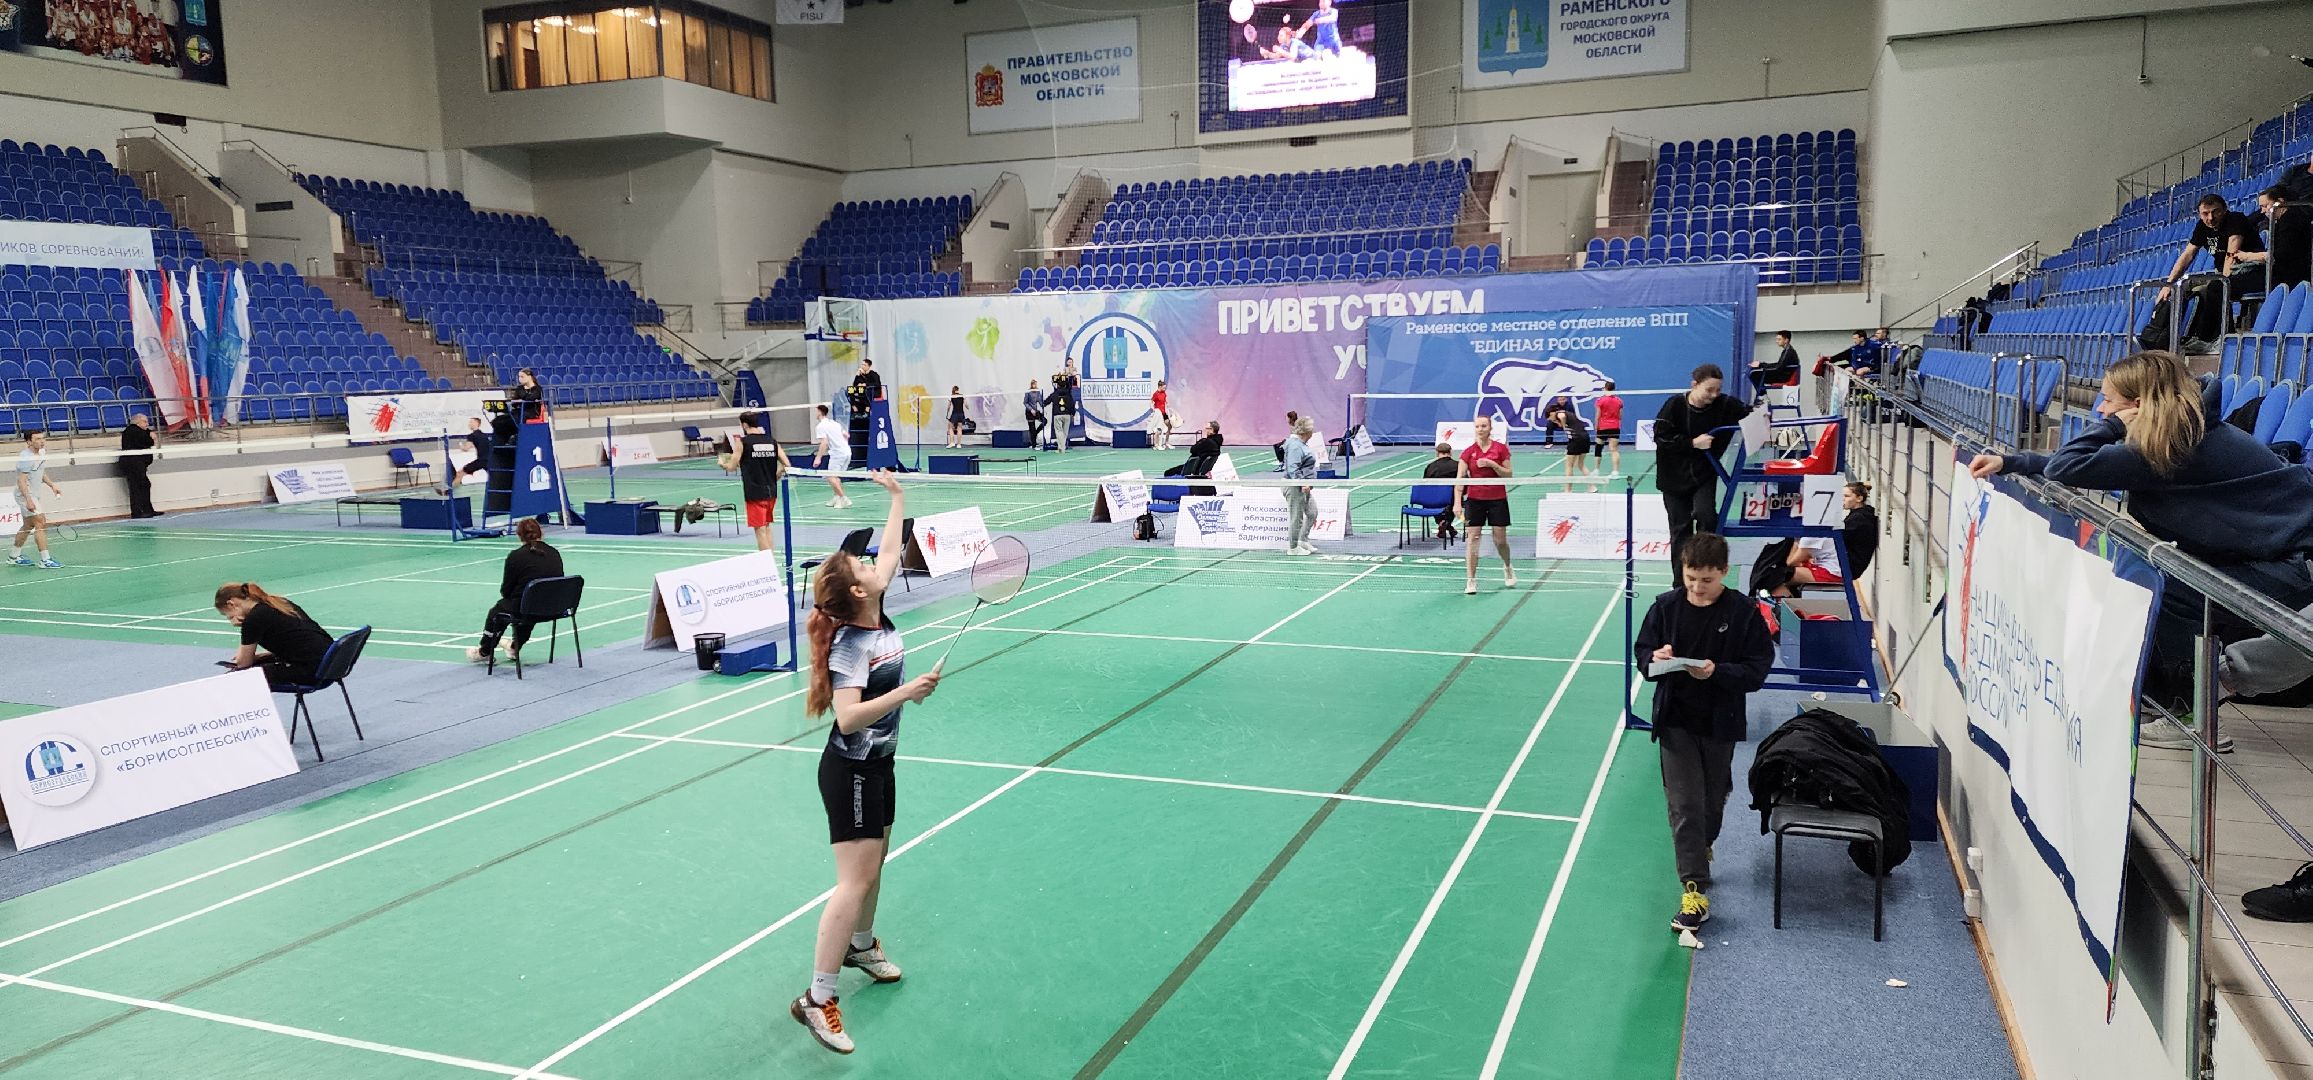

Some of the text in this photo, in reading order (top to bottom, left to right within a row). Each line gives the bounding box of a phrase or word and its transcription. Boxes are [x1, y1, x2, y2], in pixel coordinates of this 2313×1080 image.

[1560, 11, 1670, 31] ГОРОДСКОГО ОКРУГА
[1573, 25, 1656, 44] МОСКОВСКОЙ
[1007, 46, 1133, 70] ПРАВИТЕЛЬСТВО
[1586, 43, 1642, 58] ОБЛАСТИ
[1020, 64, 1121, 86] МОСКОВСКОЙ
[1036, 84, 1105, 101] ОБЛАСТИ
[41, 244, 145, 258] СОРЕВНОВАНИЙ!
[1218, 289, 1485, 335] ПРИВЕТСТВУЕМ
[1405, 313, 1689, 335] Раменское местное отделение ВПП
[878, 417, 885, 429] 3
[532, 446, 542, 462] 1
[1747, 500, 1767, 517] 21
[1812, 491, 1835, 524] 7
[100, 707, 271, 757] СПОРТИВНЫЙ КОМПЛЕКС
[116, 726, 268, 773] «БОРИСОГЛЕБСКИЙ»
